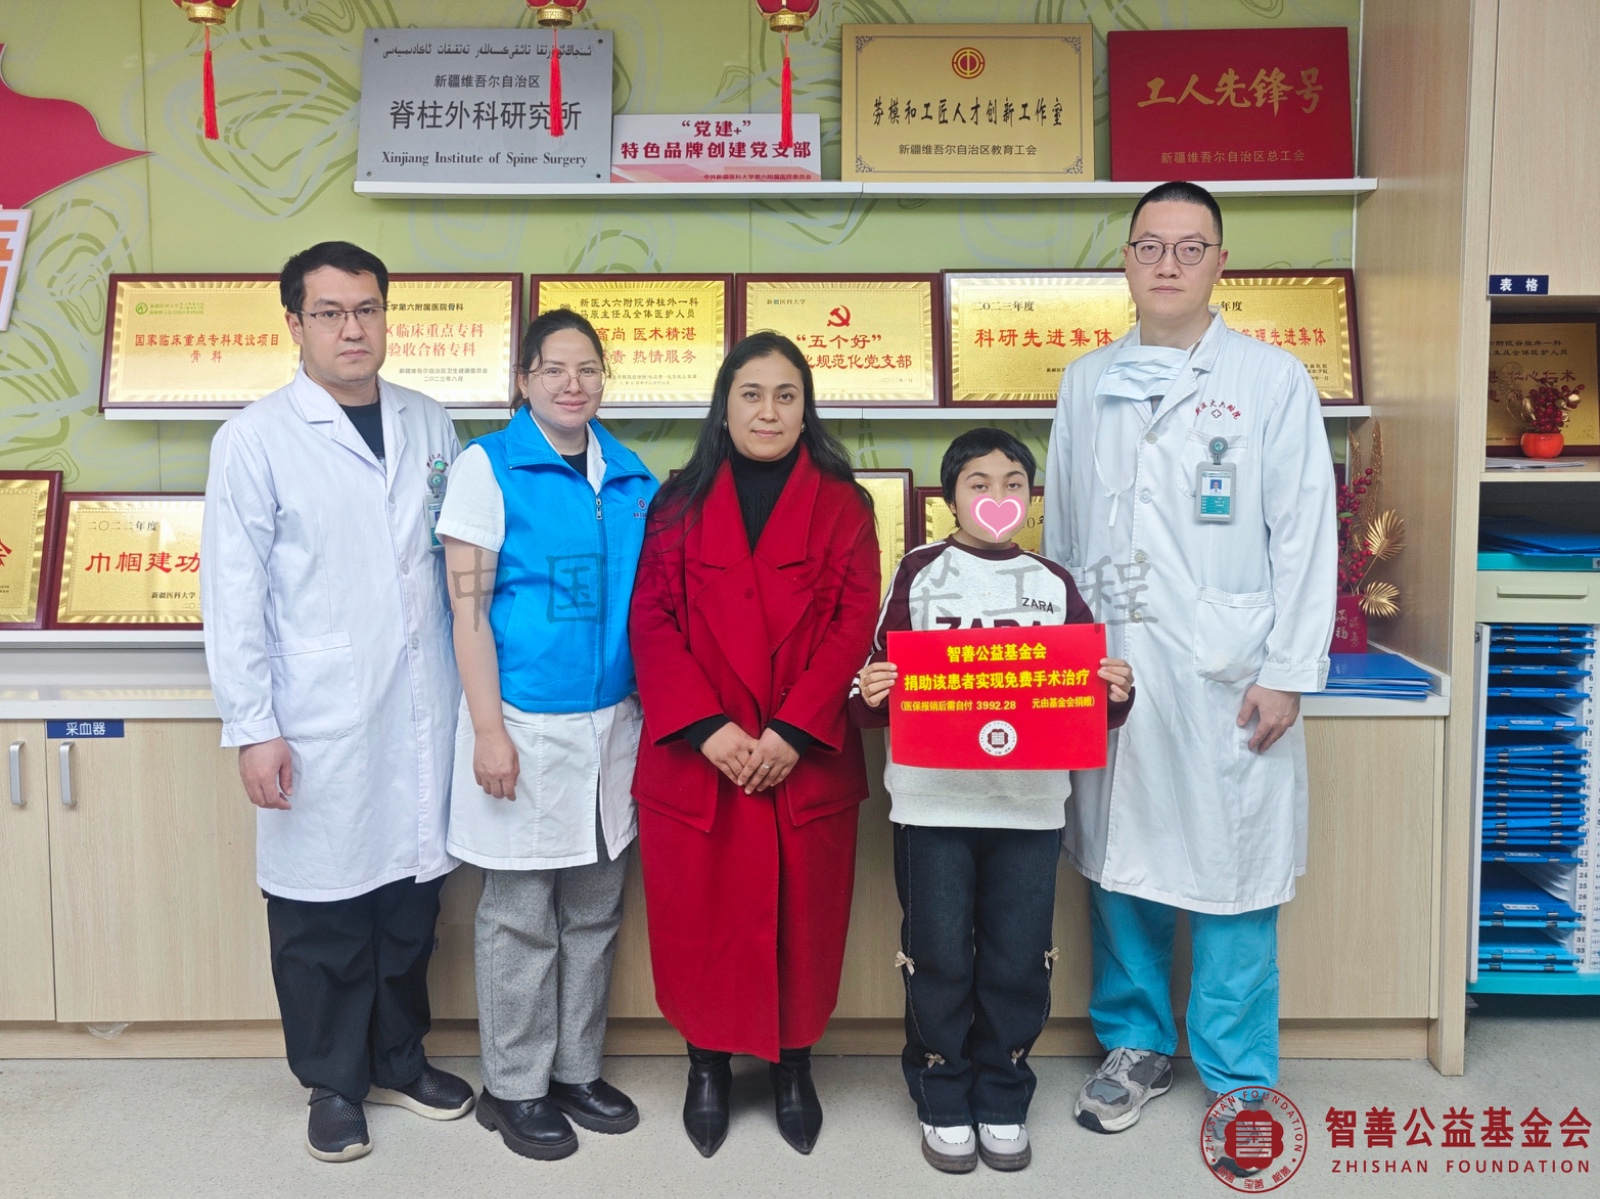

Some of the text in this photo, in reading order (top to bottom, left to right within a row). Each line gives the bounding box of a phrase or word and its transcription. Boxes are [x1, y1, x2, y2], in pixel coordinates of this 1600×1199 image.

[434, 75, 541, 88] 新疆维吾尔自治区
[1137, 67, 1323, 117] 工人先锋号
[389, 100, 583, 131] 脊柱外科研究所
[873, 97, 1063, 127] 劳模和工匠人才创新工作室
[621, 141, 812, 159] 特色品牌创建党支部
[899, 143, 1037, 156] 新疆维吾尔自治区教育工会
[1160, 149, 1305, 164] 新疆维吾尔自治区总工会
[382, 152, 588, 168] Xinjiang Institute of Spine Surgery
[579, 297, 699, 308] 新医大六附院脊柱外一科
[135, 333, 280, 347] 国家临床重点专科建设项目
[633, 327, 697, 341] 医术精湛
[795, 334, 883, 349] “五个好”
[974, 327, 1114, 349] 科研先进集体
[633, 349, 697, 364] 热情服务
[1022, 597, 1054, 614] ZARA
[947, 643, 1047, 663] 智善公益基金会
[904, 668, 1091, 691] 捐助该患者实现免费手术治疗
[976, 700, 1017, 710] 3992.28
[66, 722, 106, 736] 采血器
